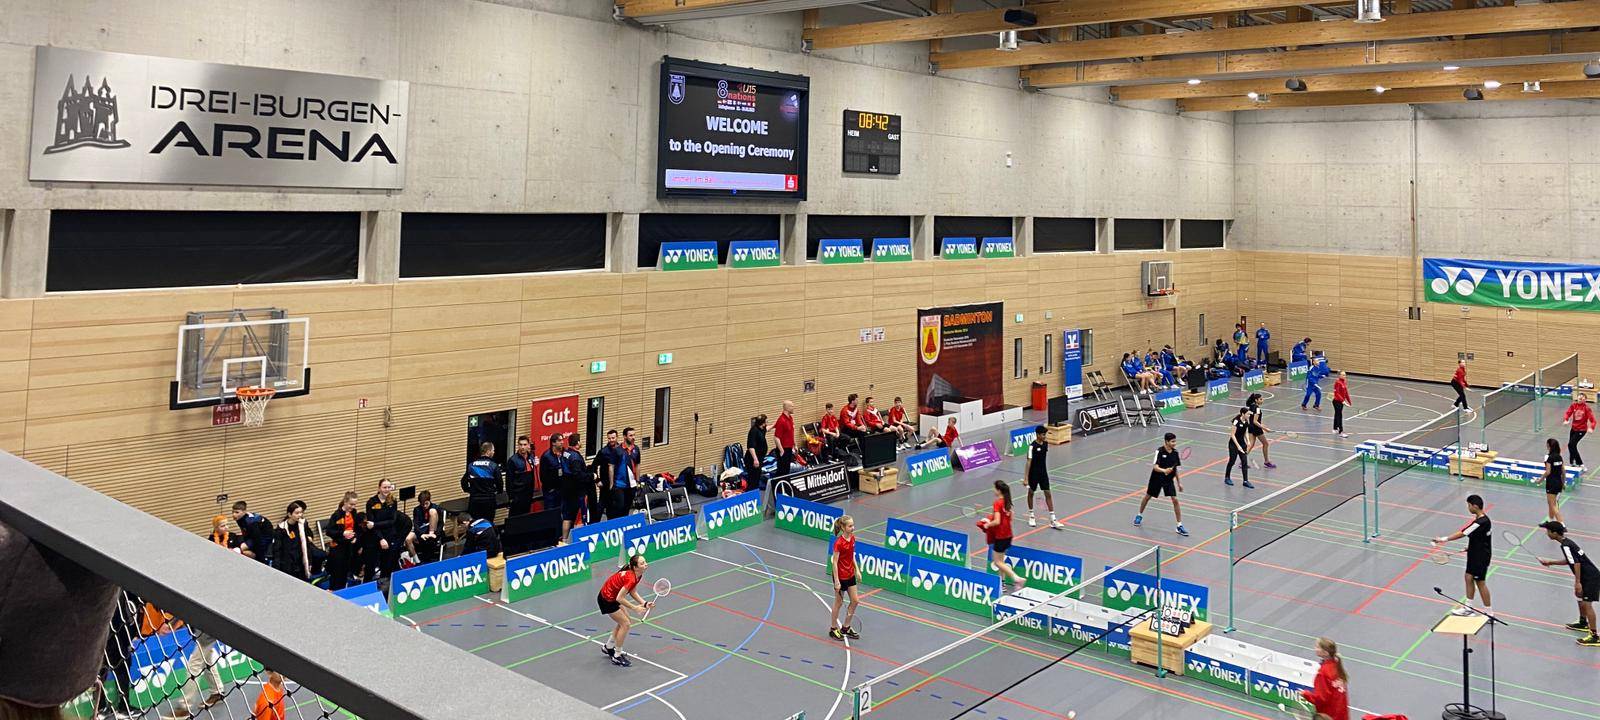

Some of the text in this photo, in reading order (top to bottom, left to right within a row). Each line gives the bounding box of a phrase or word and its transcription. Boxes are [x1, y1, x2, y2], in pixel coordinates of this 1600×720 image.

[150, 85, 402, 125] DREI-BURGEN-
[705, 116, 769, 135] WELCOME
[859, 113, 889, 131] 08:42
[149, 121, 398, 165] ARENA
[669, 139, 794, 161] to the Opening Ceremony
[684, 248, 715, 263] YONEX
[750, 247, 777, 261] YONEX
[838, 245, 860, 257] YONEX
[890, 244, 911, 256] YONEX
[955, 243, 976, 255] YONEX
[995, 242, 1013, 253] YONEX
[1495, 269, 1600, 302] YONEX
[943, 311, 993, 327] BADMINTON
[541, 407, 575, 427] Gut.
[923, 455, 950, 473] YONEX
[806, 467, 845, 489] Mitteldorf
[726, 498, 759, 522] YONEX
[653, 524, 692, 550] YONEX
[917, 534, 962, 561] YONEX
[540, 552, 586, 582] YONEX
[859, 553, 904, 582] YONEX
[1023, 559, 1076, 587] YONEX
[430, 564, 483, 595] YONEX
[943, 575, 994, 606] YONEX
[1013, 613, 1042, 630] YONEX
[1070, 629, 1101, 645] YONEX
[1208, 664, 1242, 684] YONEX
[861, 690, 869, 711] 2
